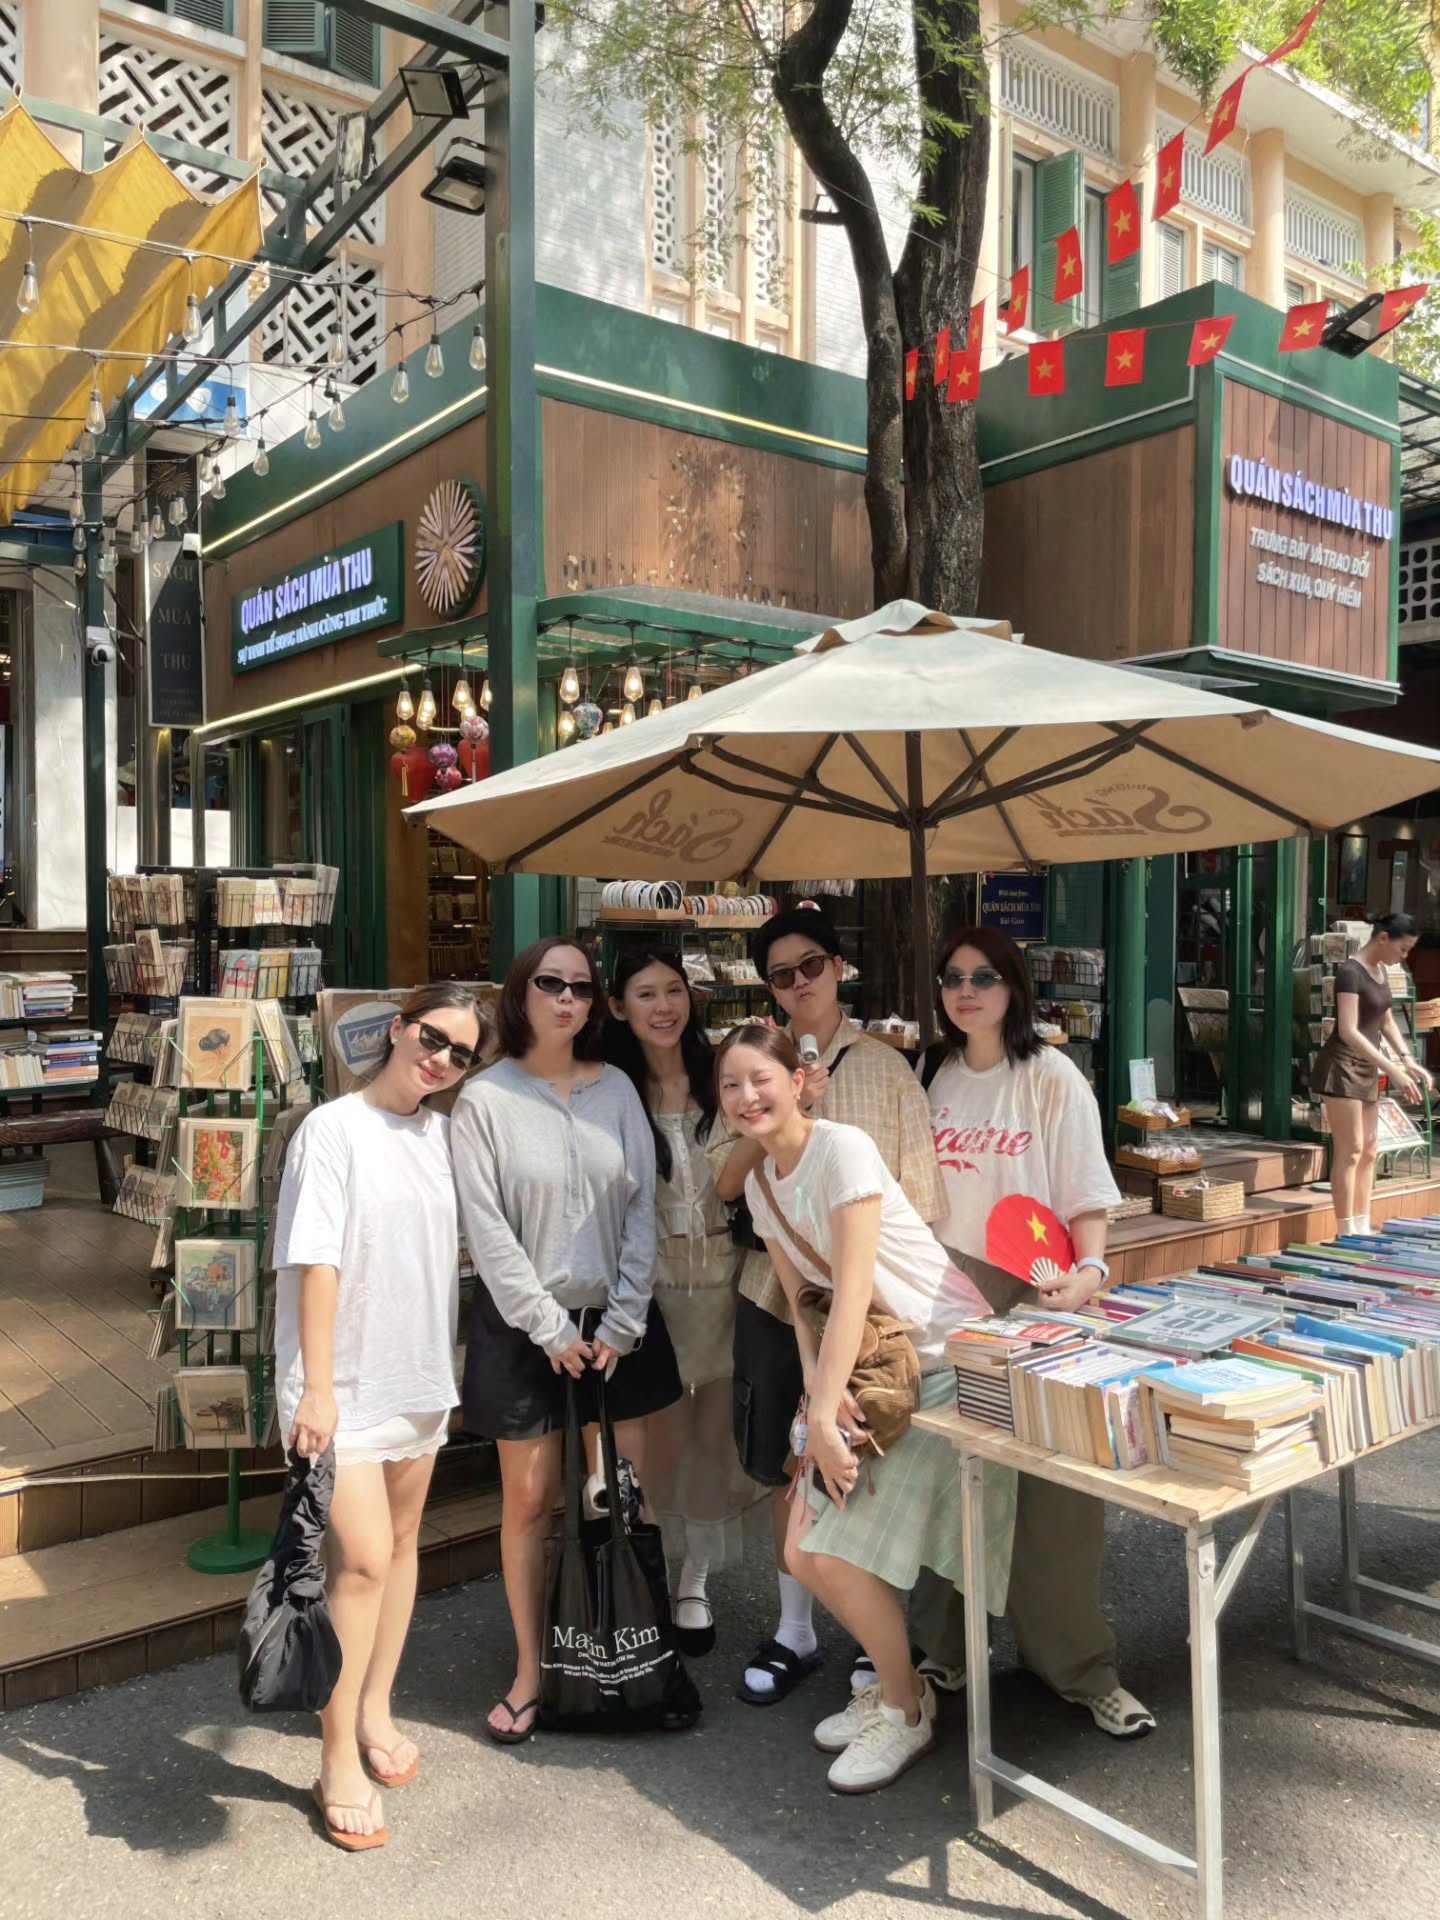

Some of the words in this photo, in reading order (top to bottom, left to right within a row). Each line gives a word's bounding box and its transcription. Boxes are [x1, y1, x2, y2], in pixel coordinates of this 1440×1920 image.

[1231, 454, 1280, 503] QUÁN
[1282, 470, 1326, 519] SÁCH
[1326, 488, 1361, 530] MÙA
[1363, 502, 1392, 540] THU
[1257, 561, 1288, 587] SÁCH
[1313, 578, 1337, 600] QUÝ
[1323, 549, 1350, 574] TRAO
[241, 587, 273, 634] QUÁN
[275, 576, 308, 619] SÁCH
[309, 556, 341, 605] MÙA
[341, 548, 372, 592] THU
[613, 1626, 660, 1654] Kim
